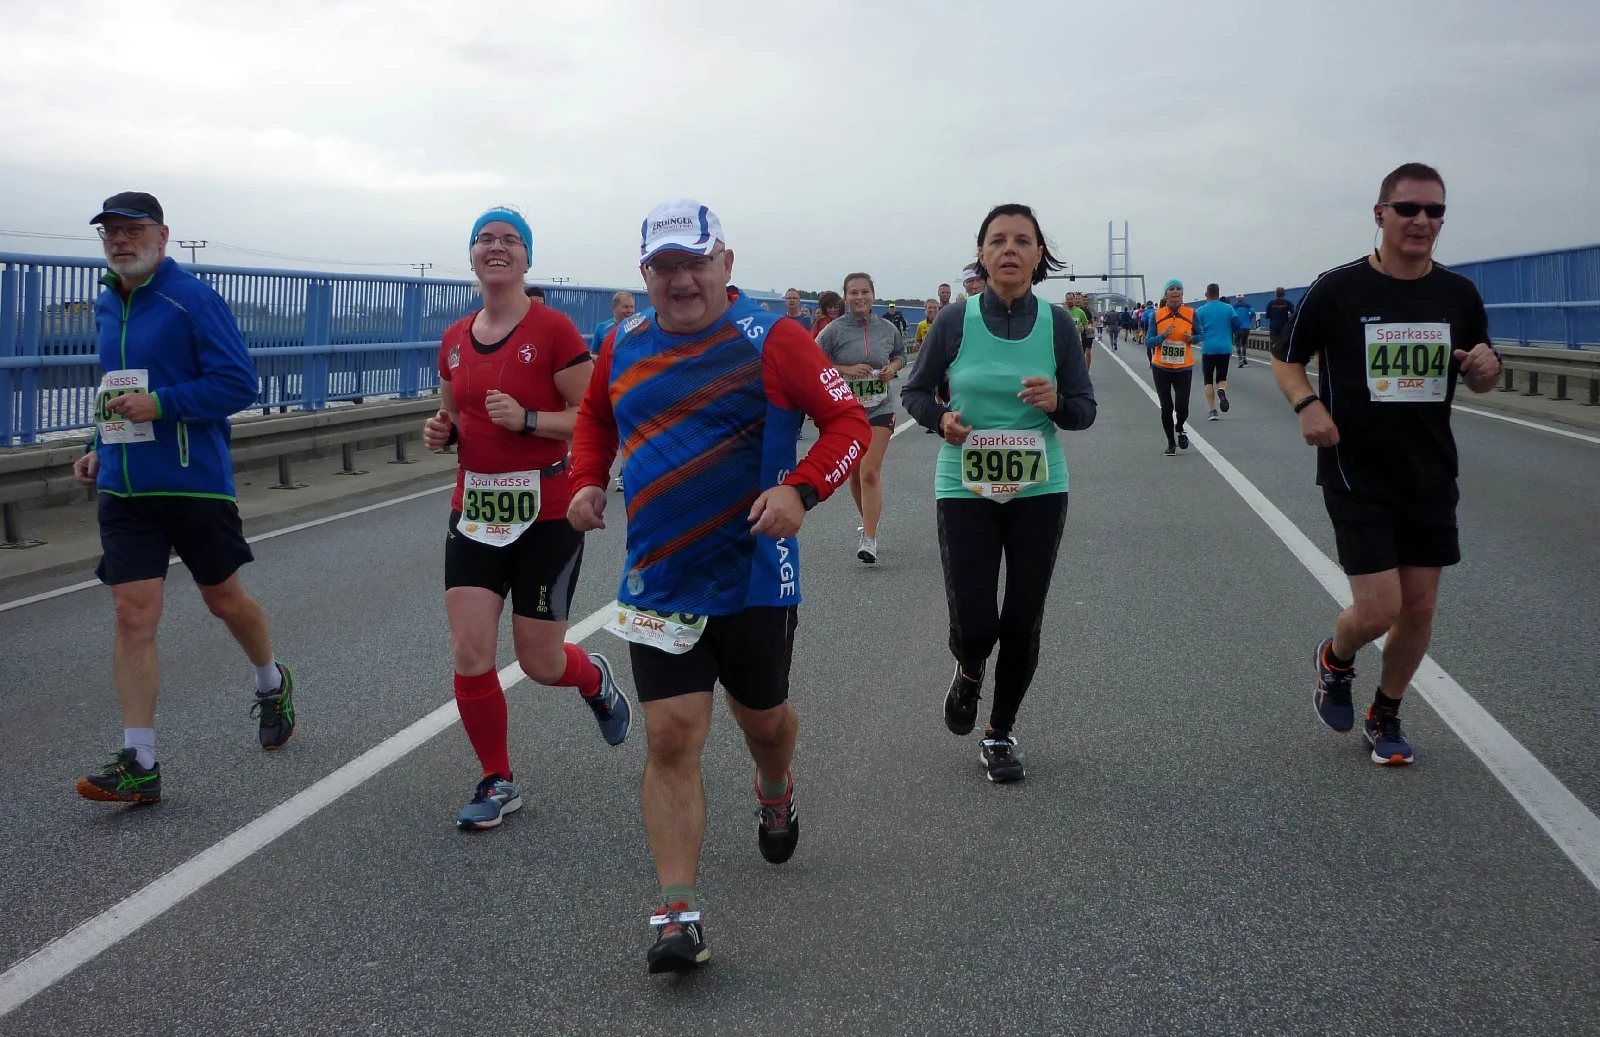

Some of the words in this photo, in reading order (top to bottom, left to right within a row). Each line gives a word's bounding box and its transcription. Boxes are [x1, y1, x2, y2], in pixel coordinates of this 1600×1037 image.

[652, 216, 693, 231] ERDINGER
[736, 316, 764, 339] AS
[1376, 327, 1443, 343] Sparkasse
[1162, 345, 1185, 357] 3836
[1371, 344, 1445, 376] 4404
[1397, 378, 1425, 389] DAK
[971, 433, 1036, 449] Sparkasse
[966, 450, 1042, 482] 3967
[470, 475, 530, 488] Sparkasse
[991, 483, 1020, 494] DAK
[466, 489, 535, 523] 3590
[486, 523, 512, 535] DAK
[632, 612, 666, 632] DAK
